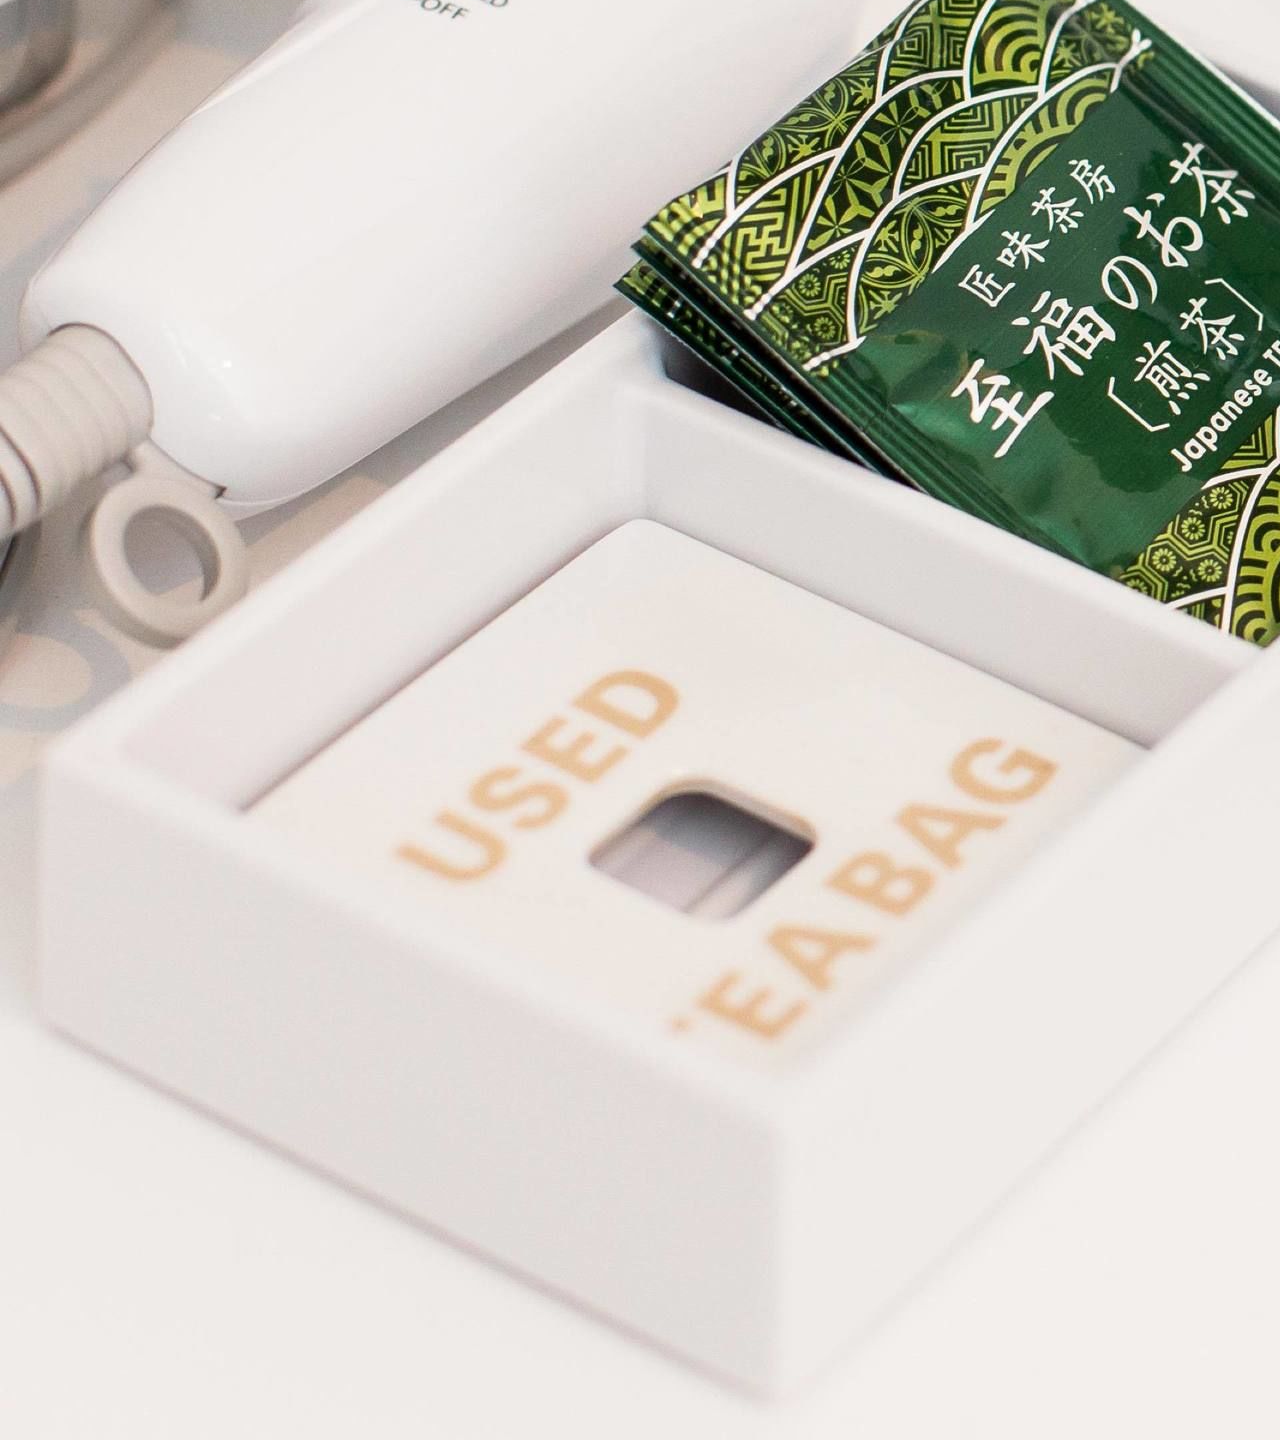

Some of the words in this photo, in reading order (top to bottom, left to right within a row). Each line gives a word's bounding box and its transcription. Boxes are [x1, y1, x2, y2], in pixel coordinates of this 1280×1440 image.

[951, 142, 1256, 459] 至福のお茶
[957, 157, 1117, 308] 匠味茶房
[1170, 368, 1274, 473] Japanese
[395, 669, 681, 884] USED
[668, 921, 877, 1043] EA
[826, 737, 1060, 919] BAG
